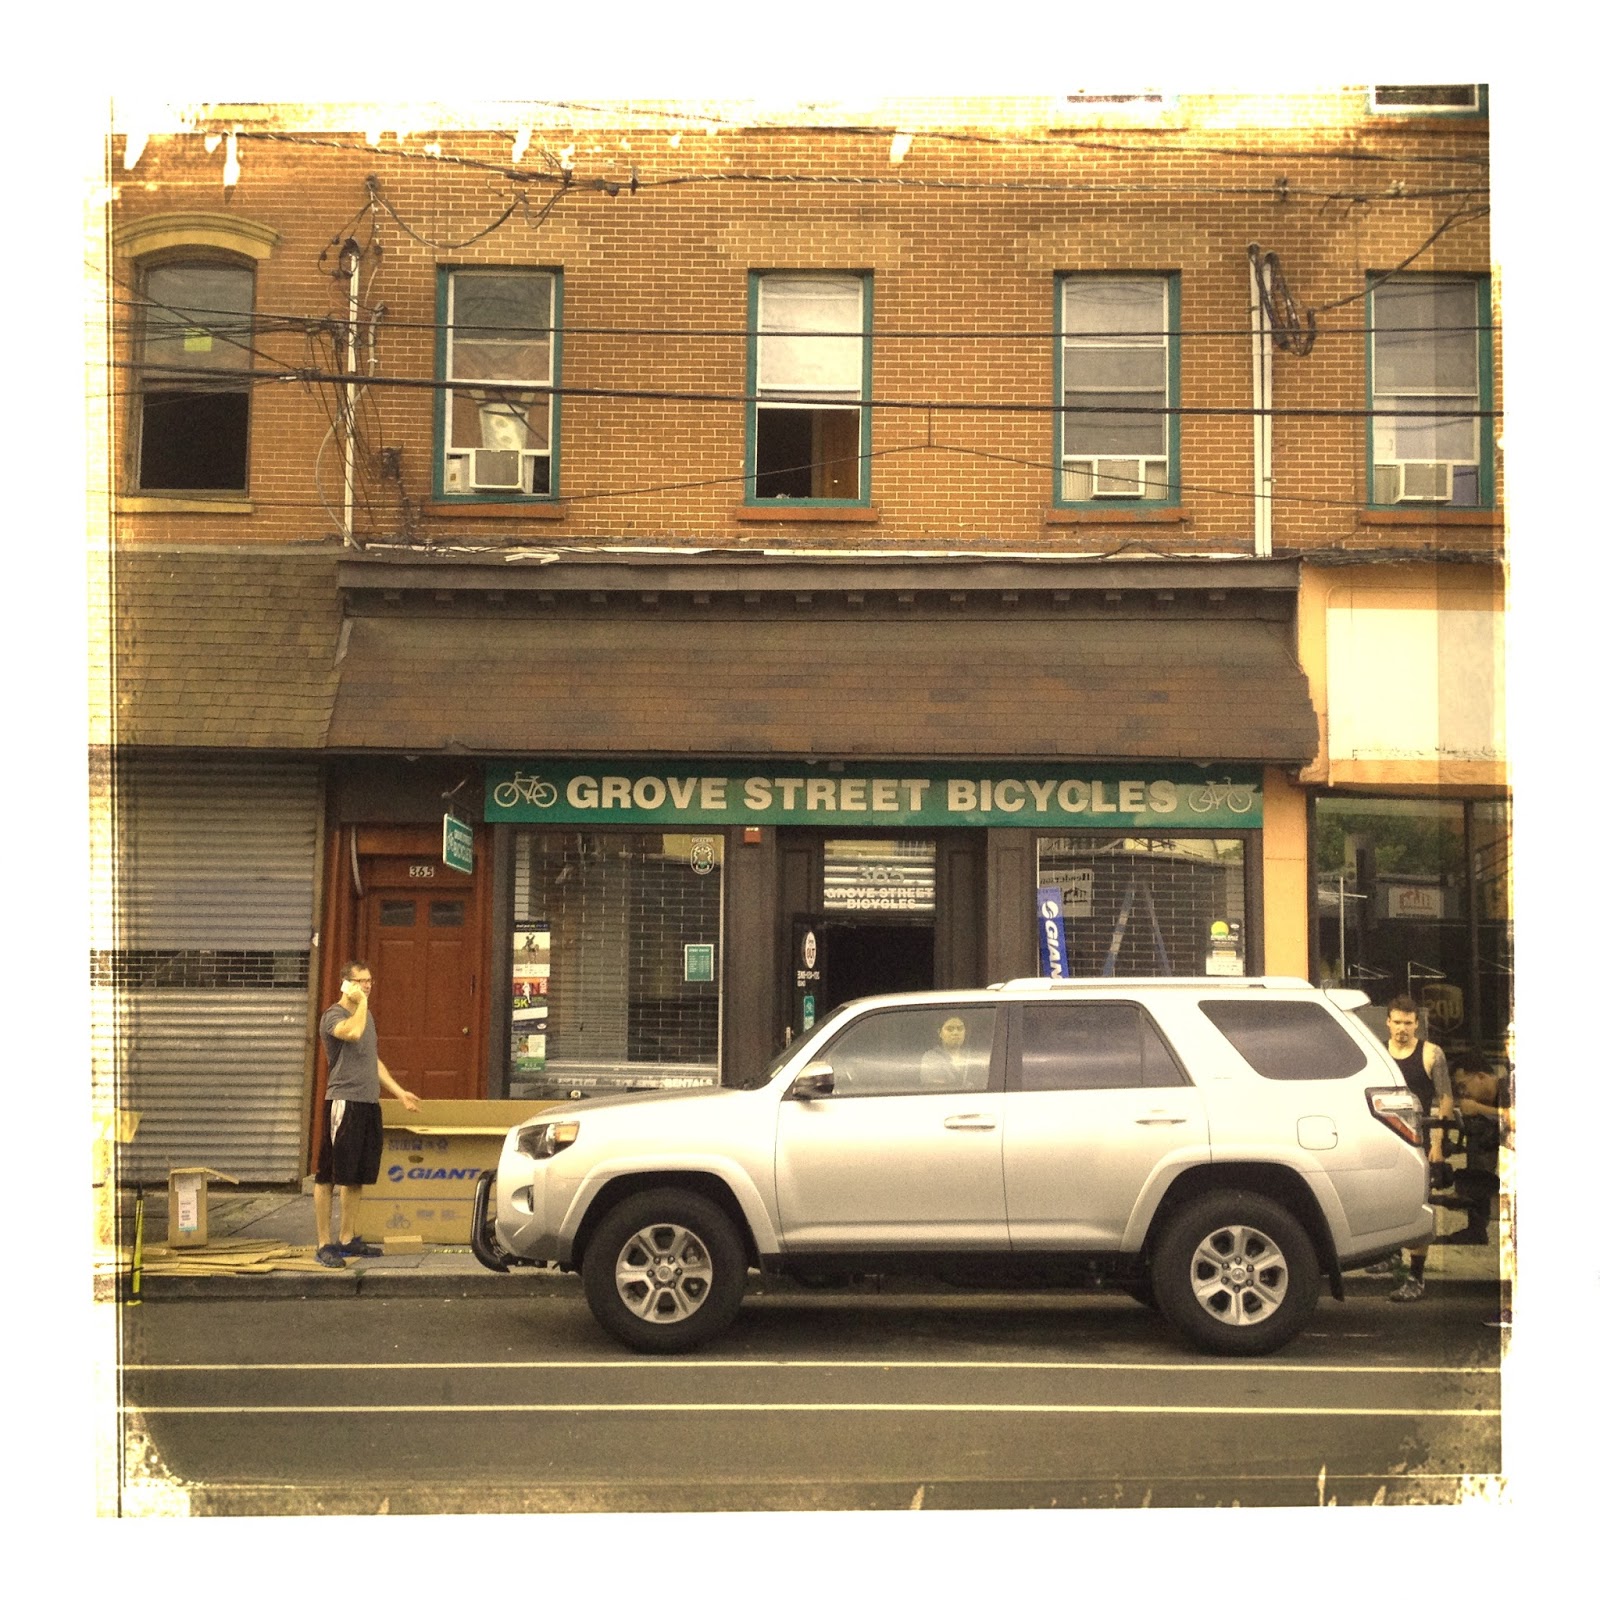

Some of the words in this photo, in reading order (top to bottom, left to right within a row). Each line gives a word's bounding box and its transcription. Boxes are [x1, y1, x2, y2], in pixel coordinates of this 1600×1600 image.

[566, 776, 728, 809] GROVE
[743, 777, 930, 811] STREET
[947, 779, 1179, 813] BICYCLES
[410, 867, 433, 877] 365
[857, 864, 905, 886] 365
[826, 887, 875, 898] GROVE
[879, 887, 934, 898] STREET
[846, 899, 916, 909] BICYCLES
[513, 983, 540, 996] RN
[514, 999, 529, 1008] 5K
[407, 1167, 480, 1180] GIANT
